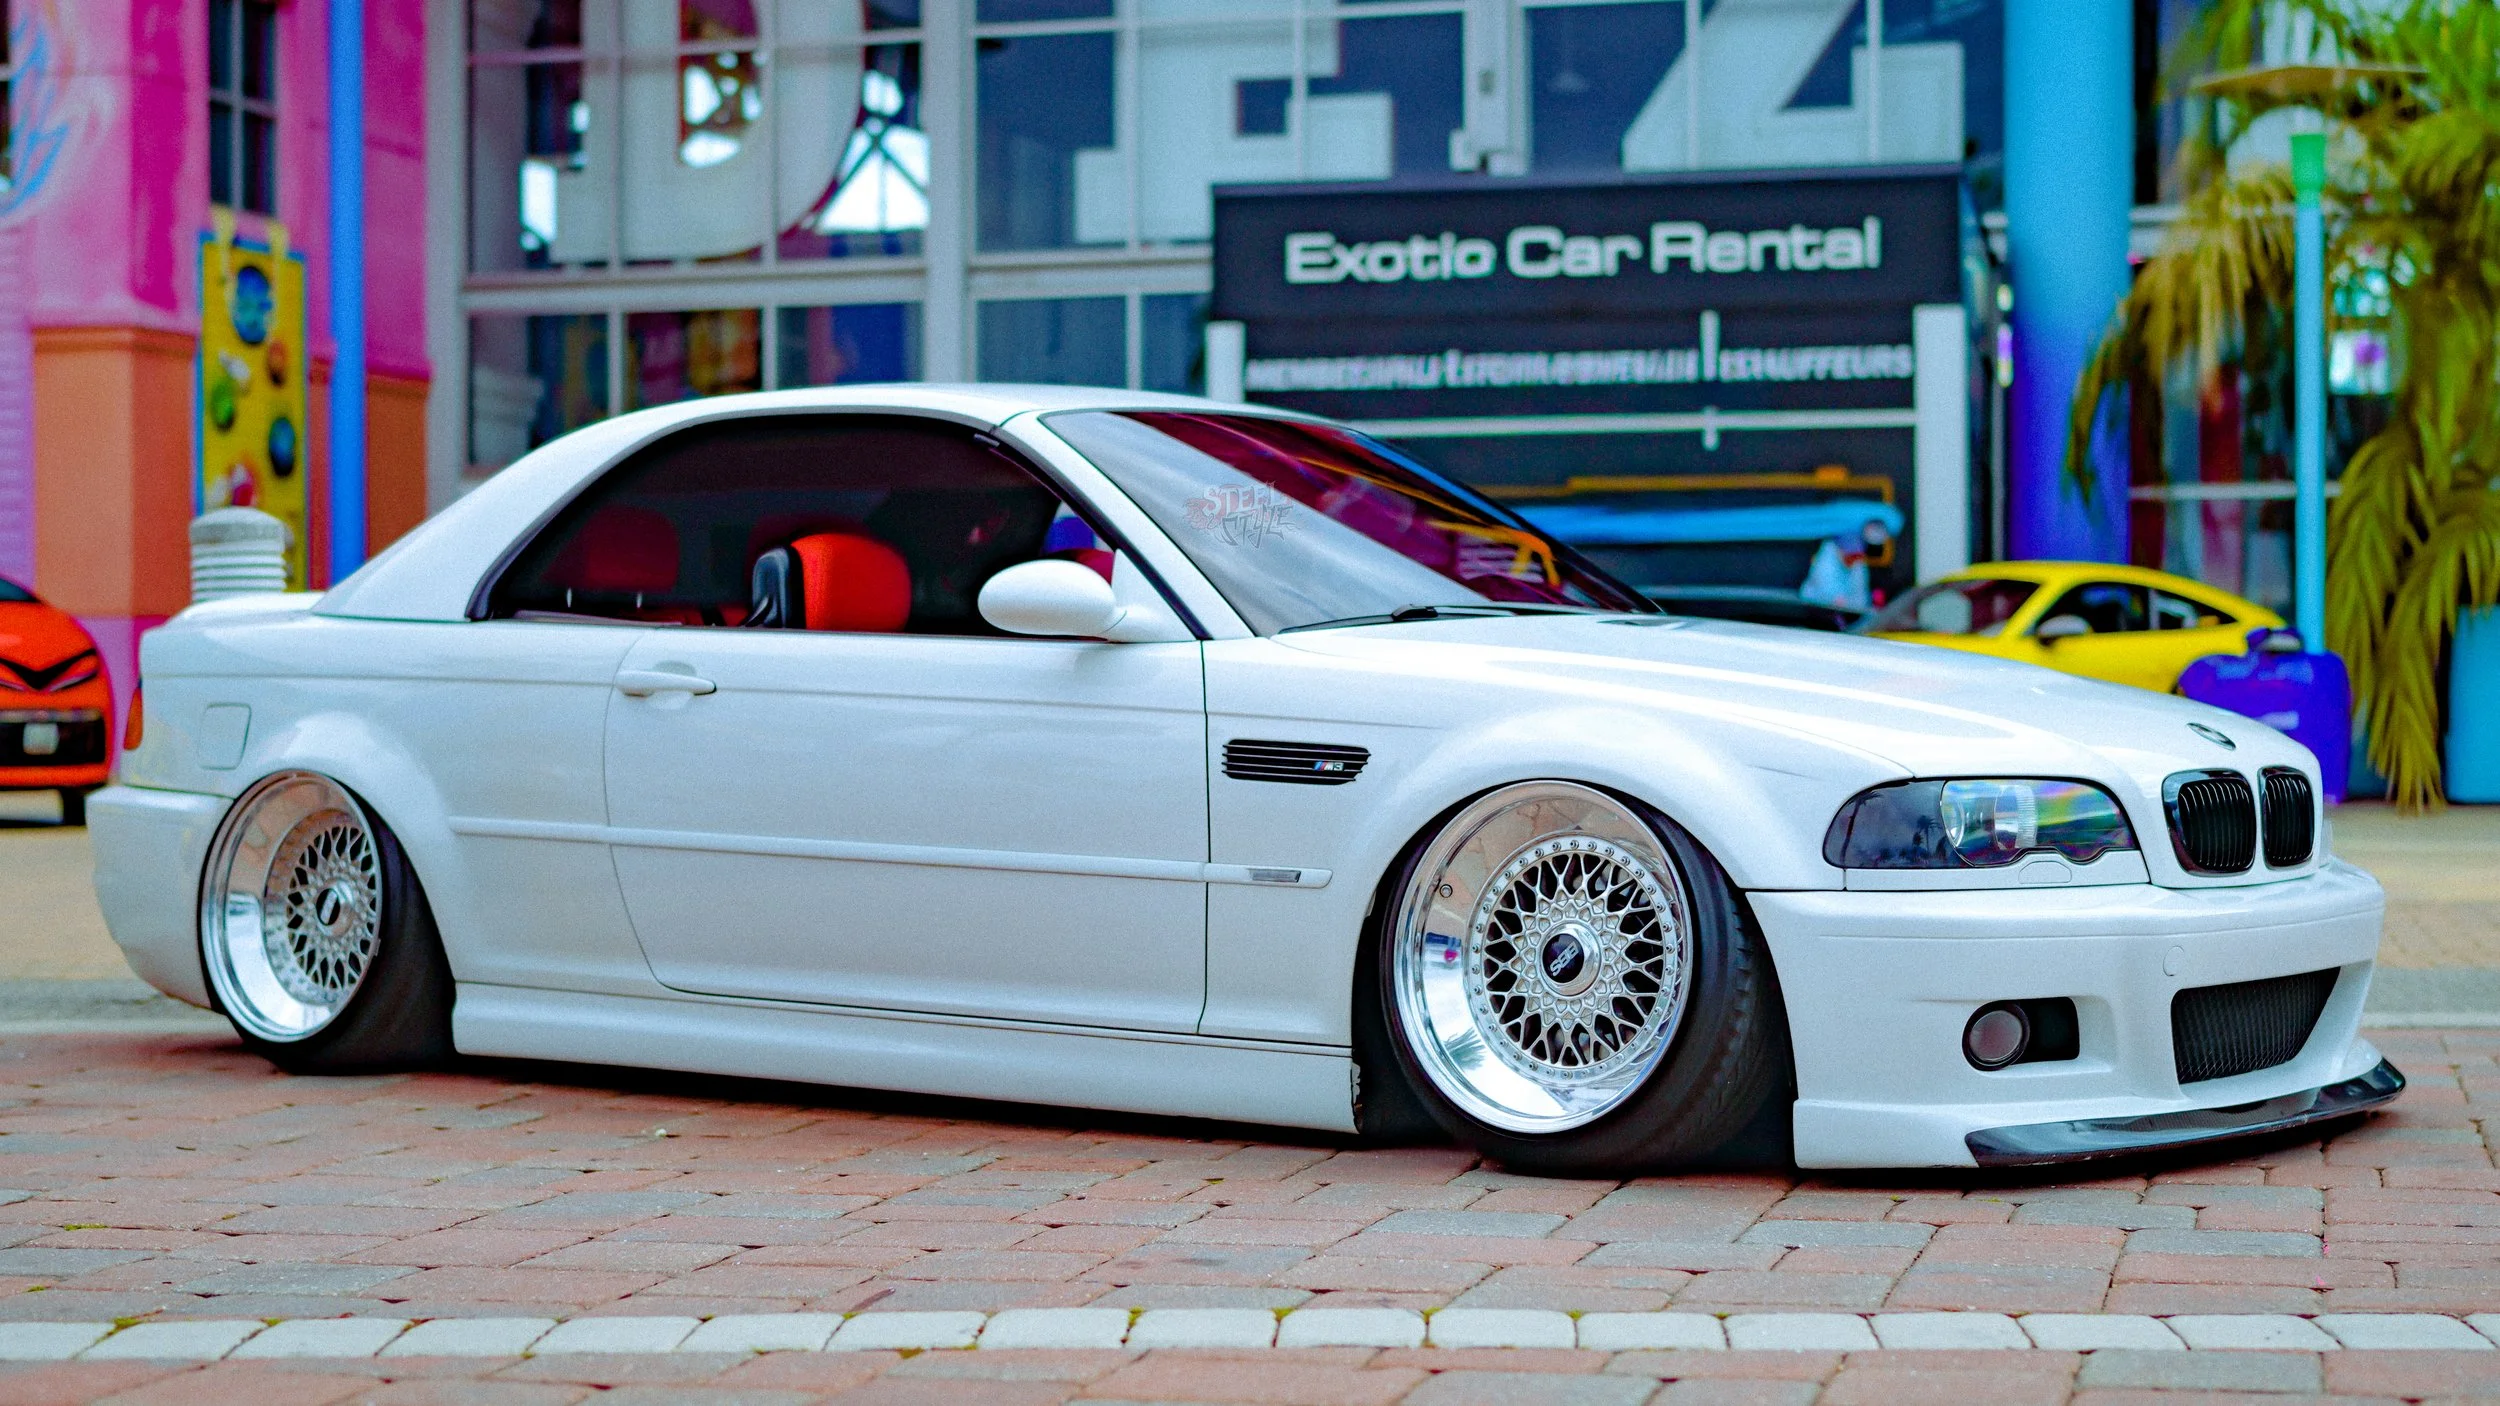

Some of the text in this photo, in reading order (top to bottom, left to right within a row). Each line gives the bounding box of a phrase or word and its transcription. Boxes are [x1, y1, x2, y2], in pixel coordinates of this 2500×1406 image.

[1285, 214, 1882, 284] Exotic Car Rental
[1317, 761, 1345, 772] M3
[1549, 940, 1580, 977] BBS
